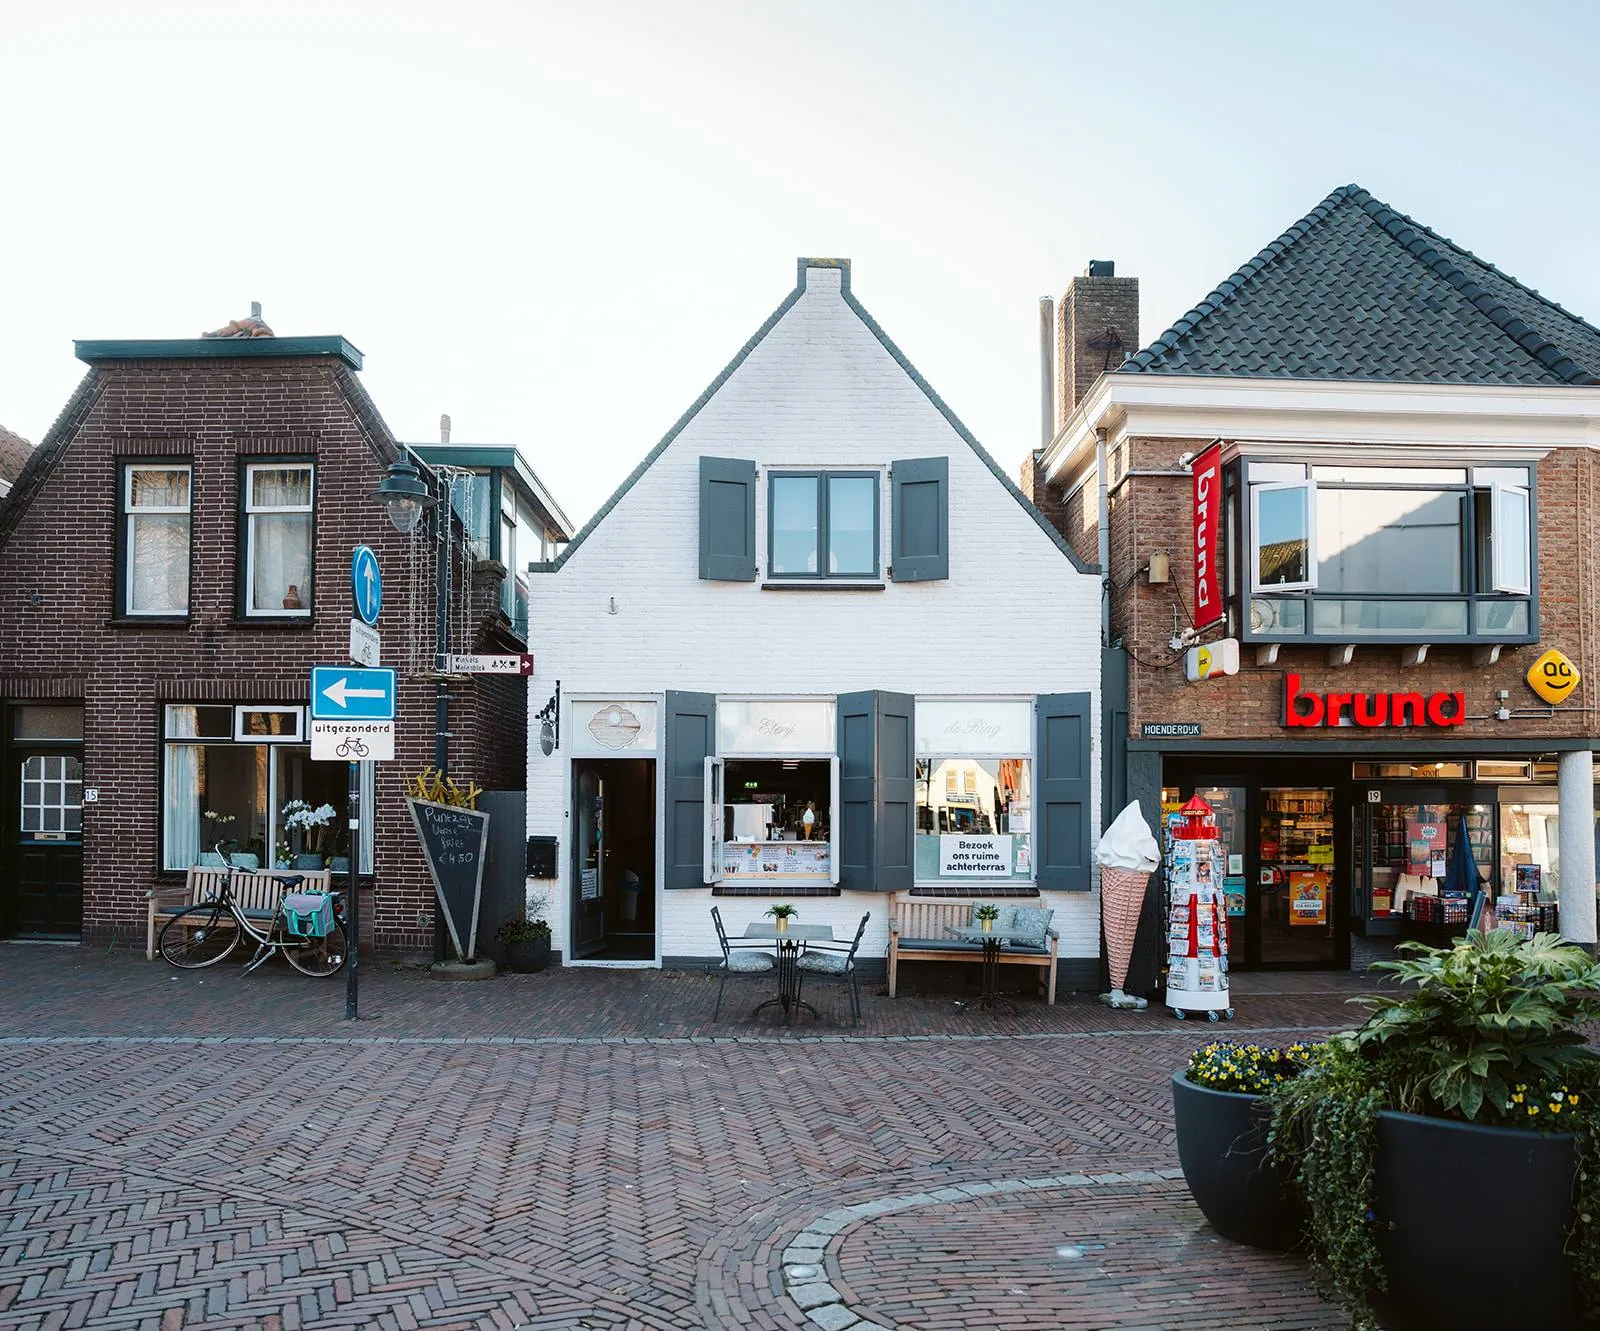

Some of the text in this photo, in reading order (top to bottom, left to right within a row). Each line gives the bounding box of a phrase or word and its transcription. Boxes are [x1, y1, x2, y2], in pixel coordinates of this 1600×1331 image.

[1197, 466, 1216, 608] bruna
[1286, 672, 1465, 727] bruna
[315, 724, 390, 735] uitgezonderd
[1144, 725, 1199, 735] HOENDERDIJK
[86, 790, 97, 800] 15
[1369, 791, 1380, 801] 19
[959, 840, 994, 850] Bezoek
[971, 852, 1000, 860] ruime
[946, 863, 1006, 871] achterterras
